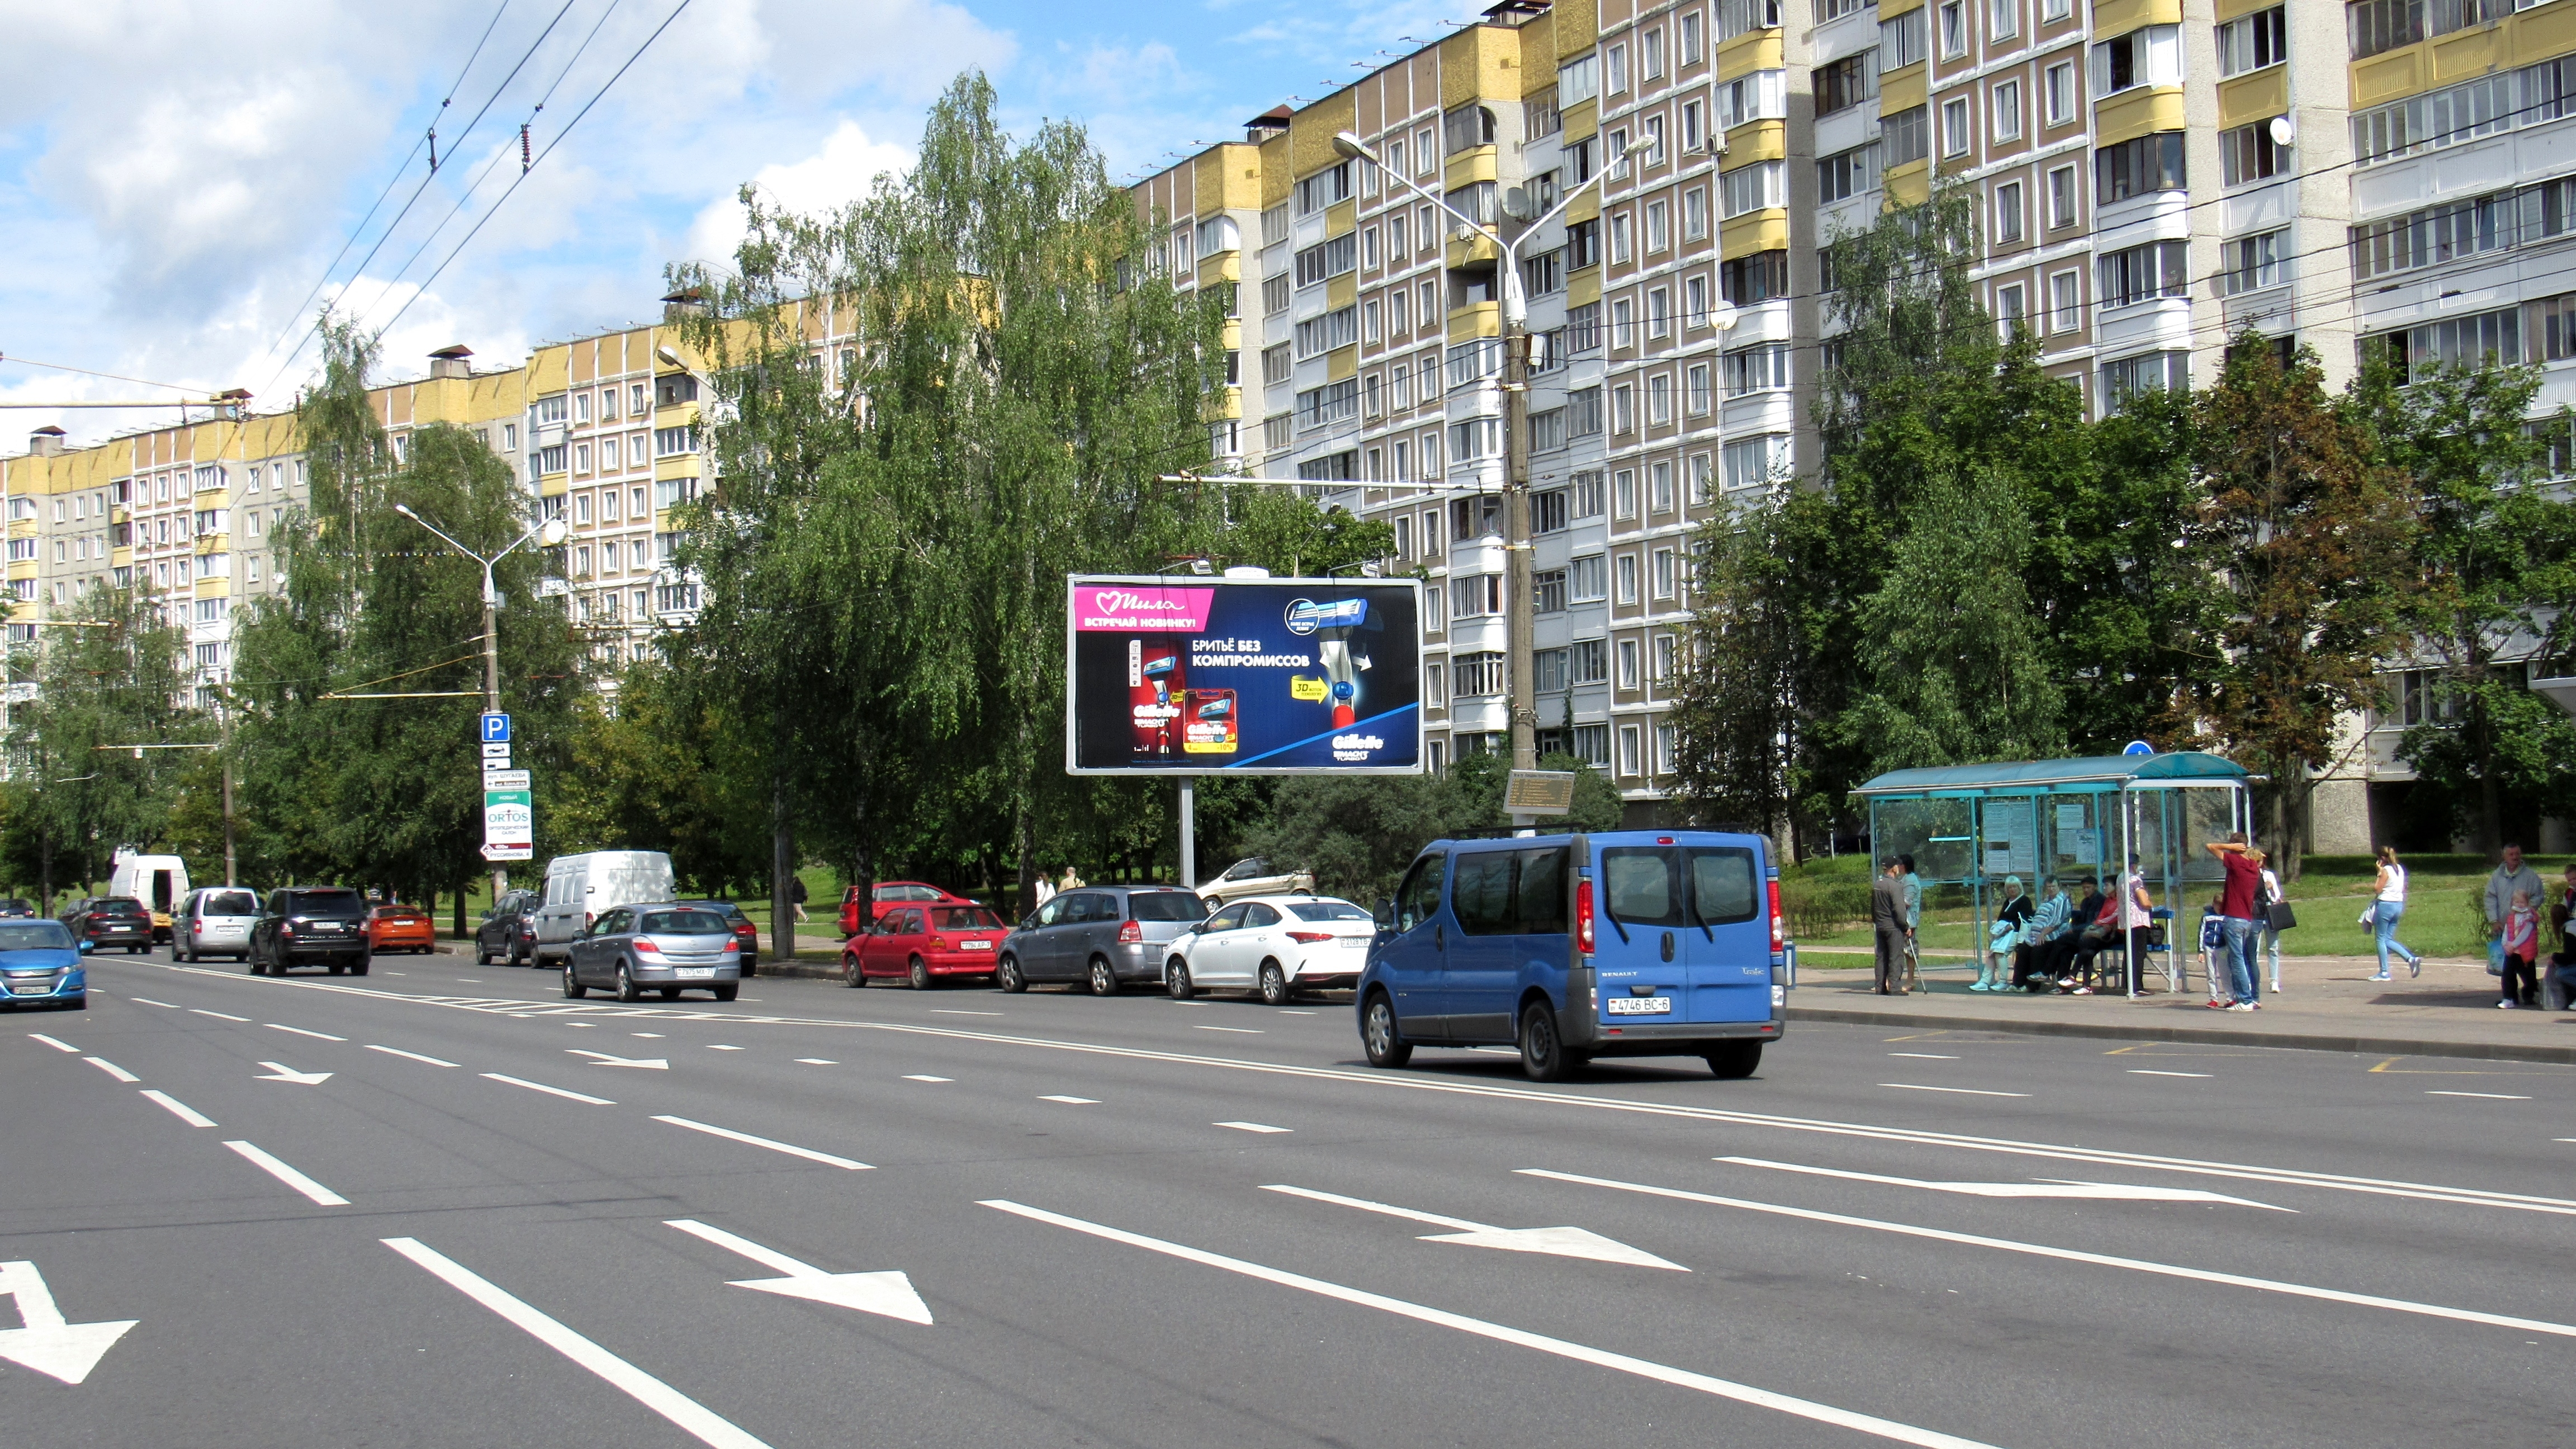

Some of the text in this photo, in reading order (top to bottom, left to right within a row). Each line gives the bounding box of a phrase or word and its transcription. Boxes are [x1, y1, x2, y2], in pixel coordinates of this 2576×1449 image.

[1110, 593, 1185, 613] Мила
[1085, 617, 1196, 627] ВСТРЕЧАЙ НОВИНКУ!
[1192, 638, 1261, 652] БРИТЬЁ БЕЗ
[1192, 655, 1310, 667] КОМПРОМИССОВ
[1133, 704, 1180, 718] Gillette
[489, 718, 503, 738] P
[1187, 723, 1228, 735] Gillette
[1332, 734, 1384, 749] Gillette
[488, 812, 528, 822] ORTOS
[1618, 999, 1668, 1010] 4746 BC-6
